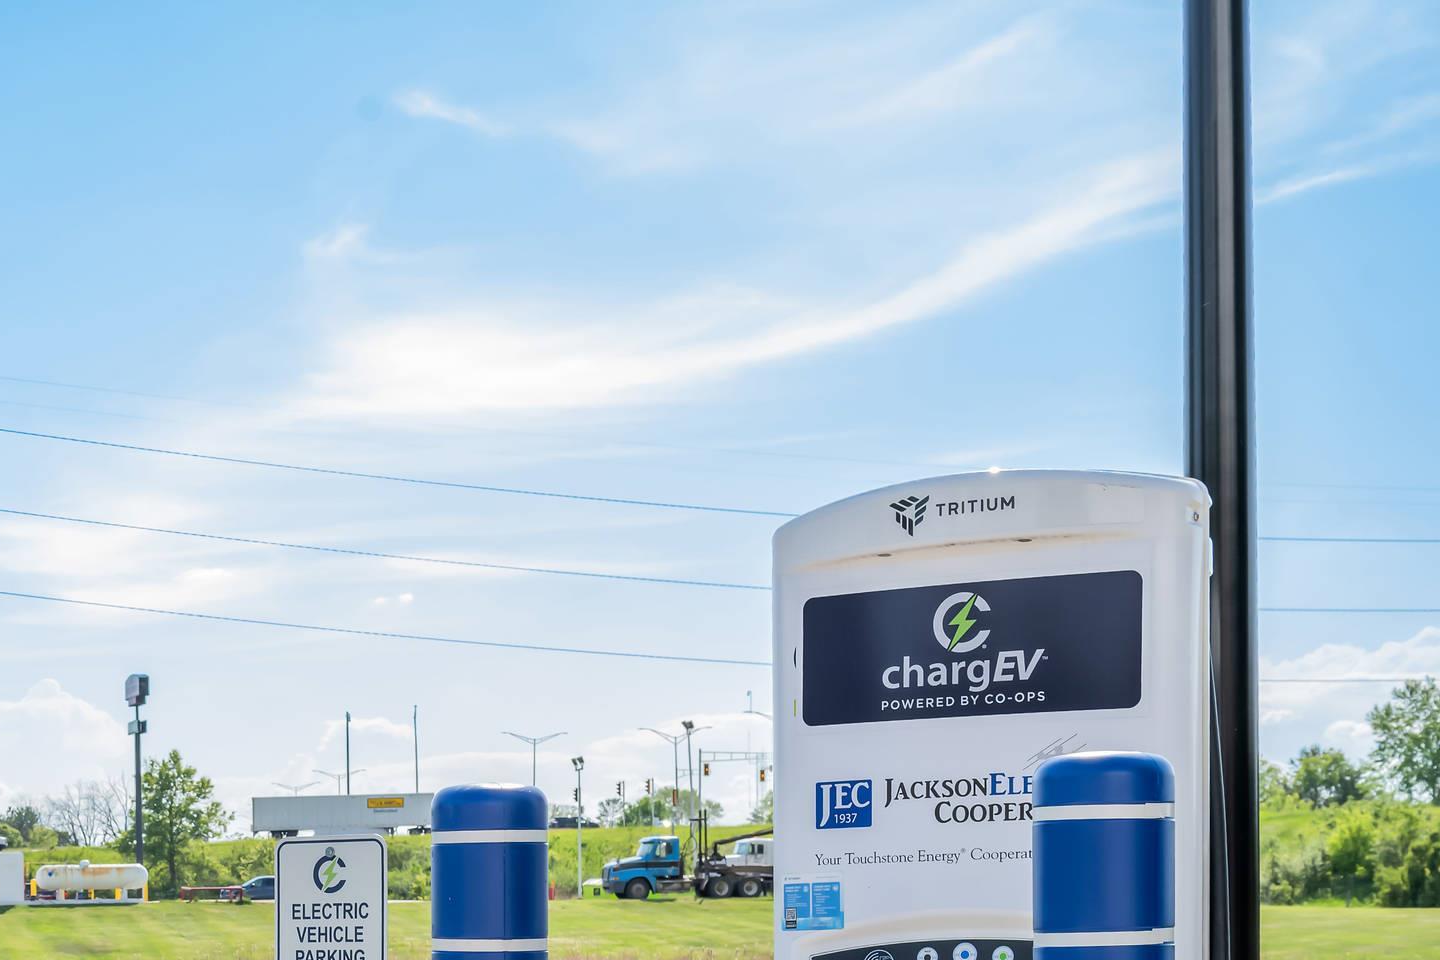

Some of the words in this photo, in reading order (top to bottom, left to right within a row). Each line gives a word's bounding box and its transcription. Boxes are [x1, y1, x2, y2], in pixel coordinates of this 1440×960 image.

[935, 495, 1015, 517] TRITIUM
[881, 696, 955, 711] POWERED
[960, 694, 980, 706] BY
[984, 691, 1046, 705] CO-OPS
[819, 781, 871, 828] JEC
[833, 812, 858, 825] 1937
[815, 853, 842, 866] Your
[844, 851, 914, 865] Touchstone
[291, 902, 370, 920] ELECTRIC
[296, 926, 364, 943] VEHICLE
